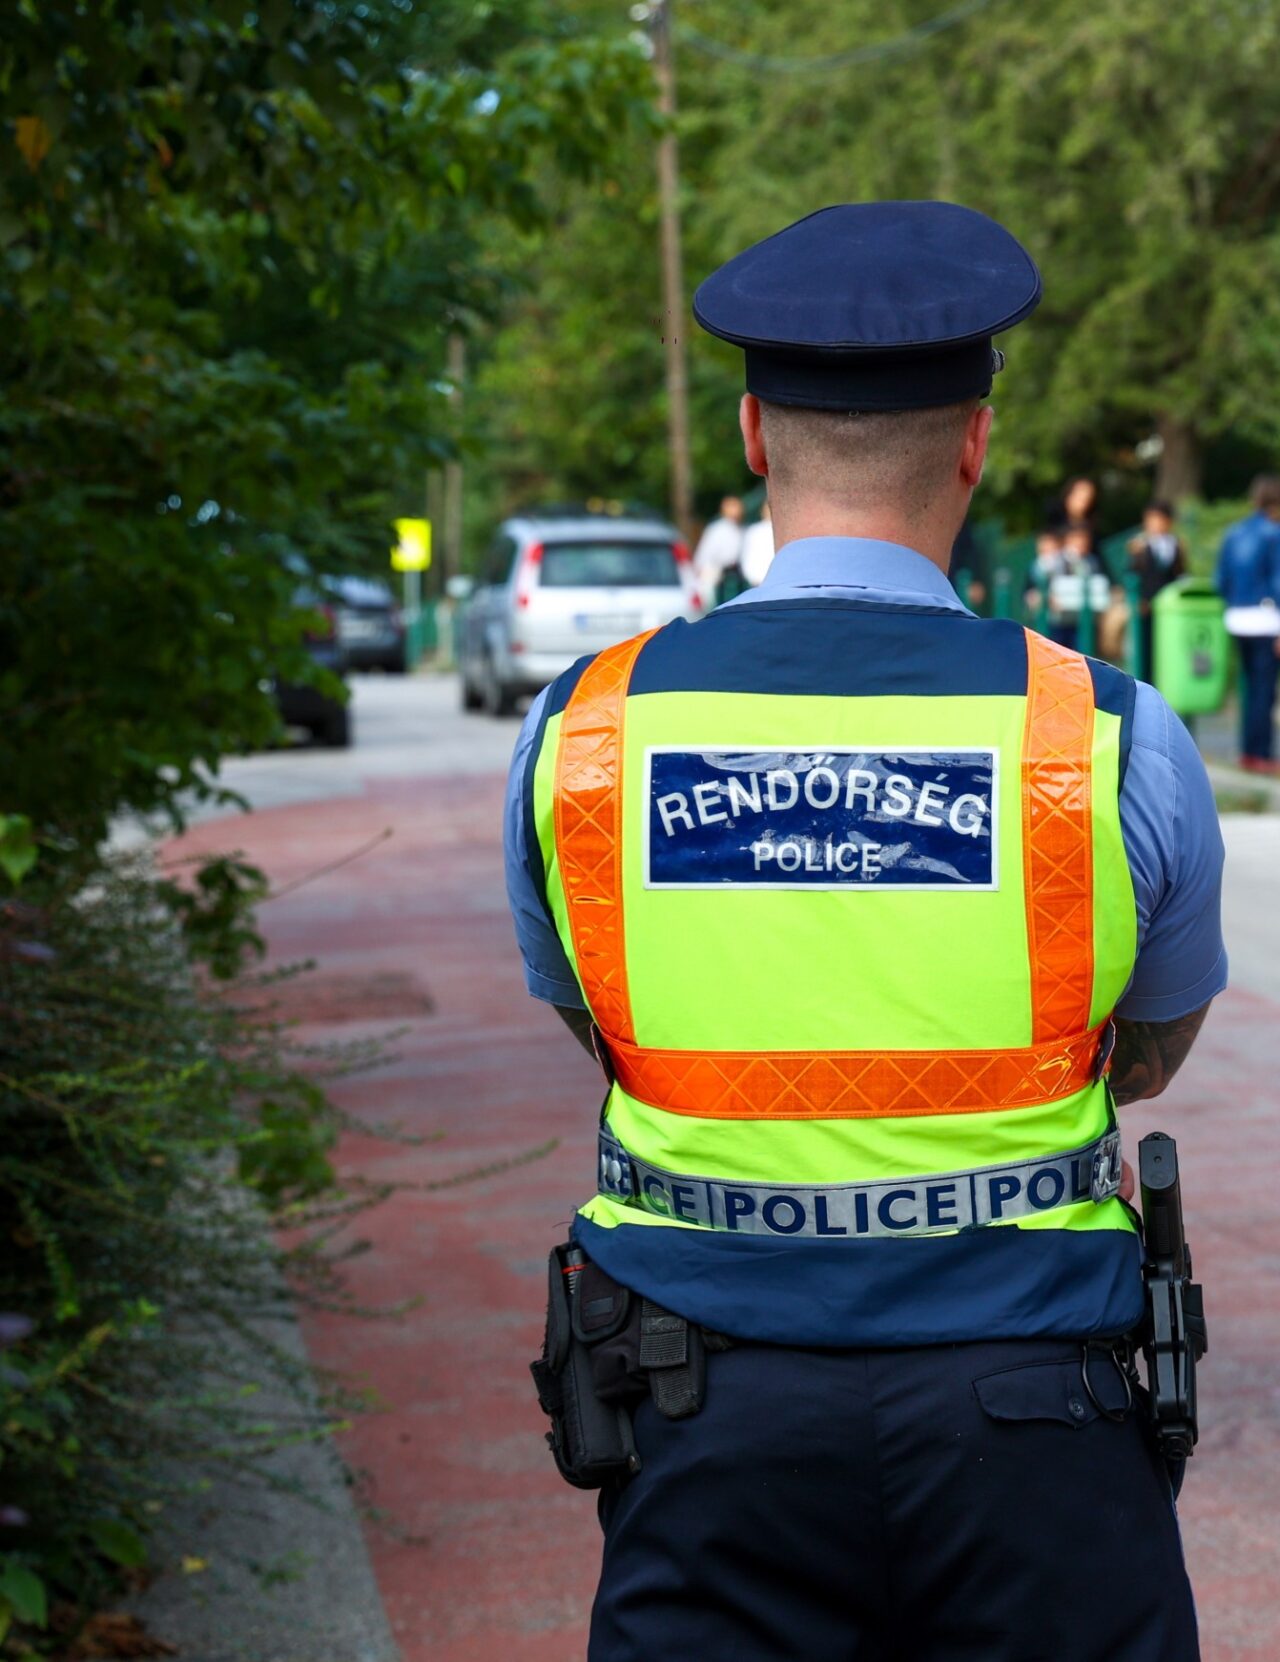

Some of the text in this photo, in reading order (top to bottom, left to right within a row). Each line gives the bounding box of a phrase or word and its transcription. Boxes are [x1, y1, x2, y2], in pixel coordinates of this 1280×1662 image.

[656, 756, 986, 839] RENDŐRSÉG
[754, 842, 882, 873] POLICE
[725, 1183, 958, 1235] POLICE
